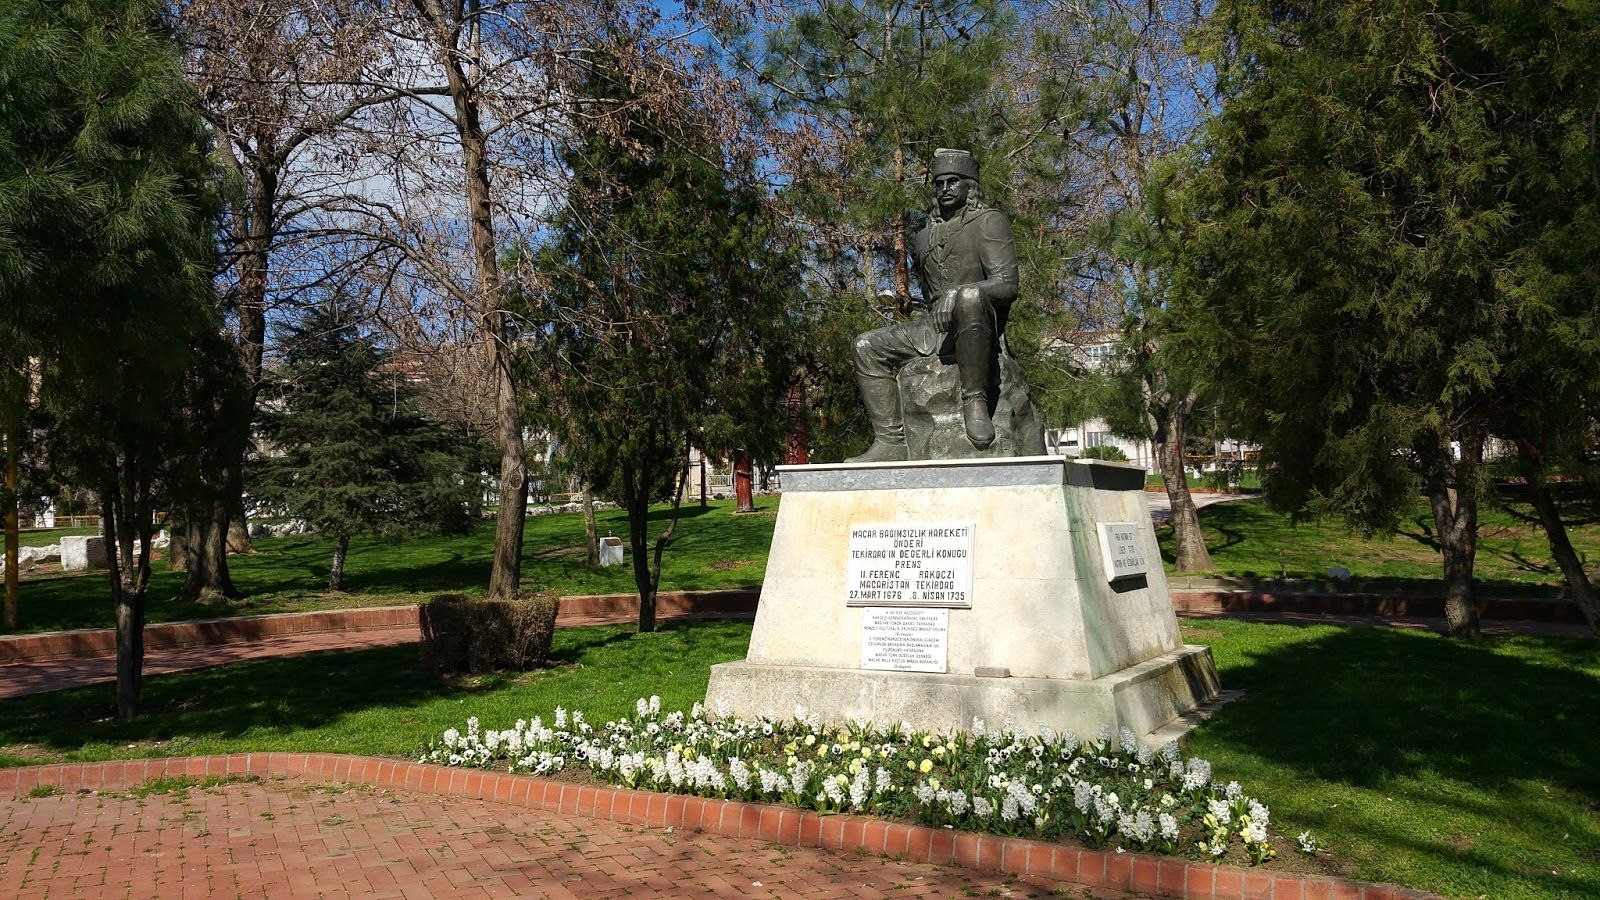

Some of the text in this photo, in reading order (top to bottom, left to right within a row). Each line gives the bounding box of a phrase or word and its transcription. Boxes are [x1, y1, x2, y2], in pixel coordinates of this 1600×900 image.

[852, 530, 877, 538] MACAR
[895, 560, 921, 568] PRENS
[884, 591, 902, 600] 1676
[948, 592, 965, 600] 1735
